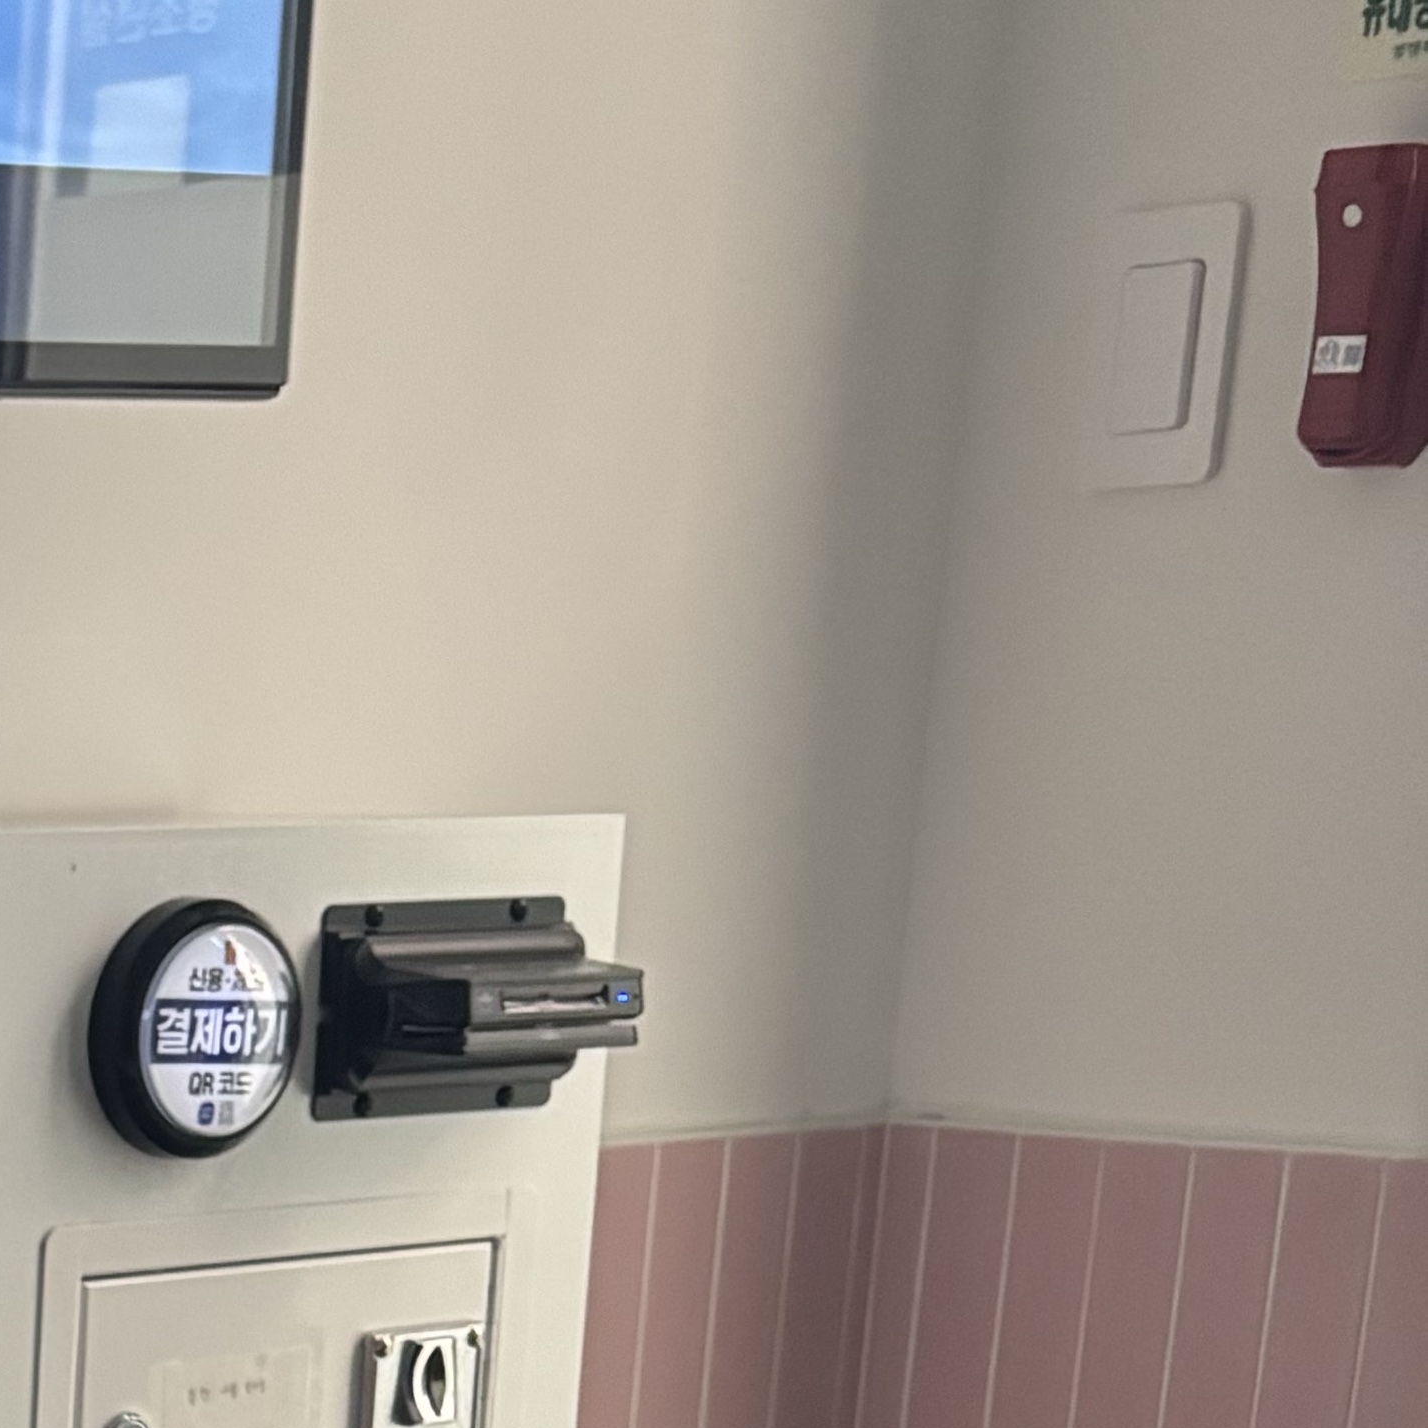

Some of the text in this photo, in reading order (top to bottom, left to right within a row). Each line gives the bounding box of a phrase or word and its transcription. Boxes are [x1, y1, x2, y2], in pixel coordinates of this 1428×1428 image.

[156, 1007, 288, 1056] 결제하기
[188, 1070, 253, 1096] QR 코드
